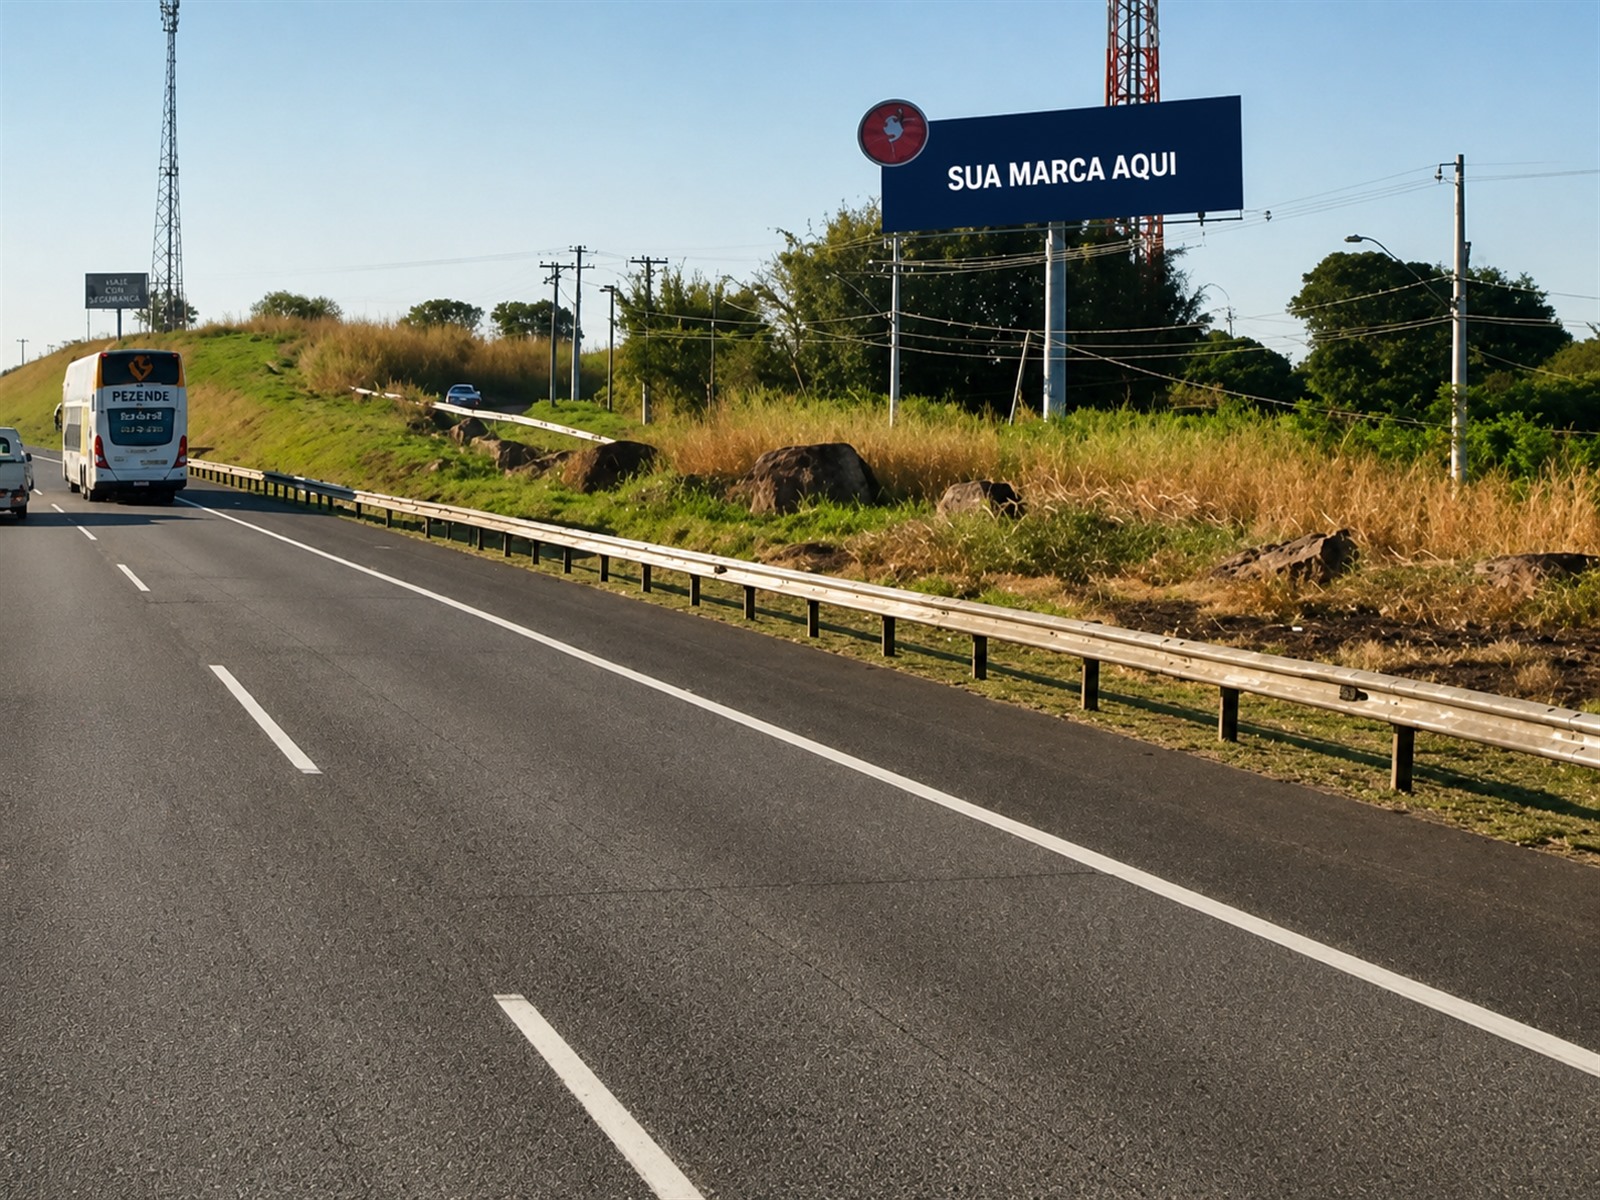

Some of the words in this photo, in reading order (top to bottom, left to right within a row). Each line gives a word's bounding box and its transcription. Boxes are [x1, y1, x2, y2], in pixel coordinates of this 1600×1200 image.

[948, 163, 1002, 191] SUA
[1009, 156, 1106, 187] MARCA
[1111, 151, 1176, 181] AQUI
[112, 391, 169, 401] PEZENDE
